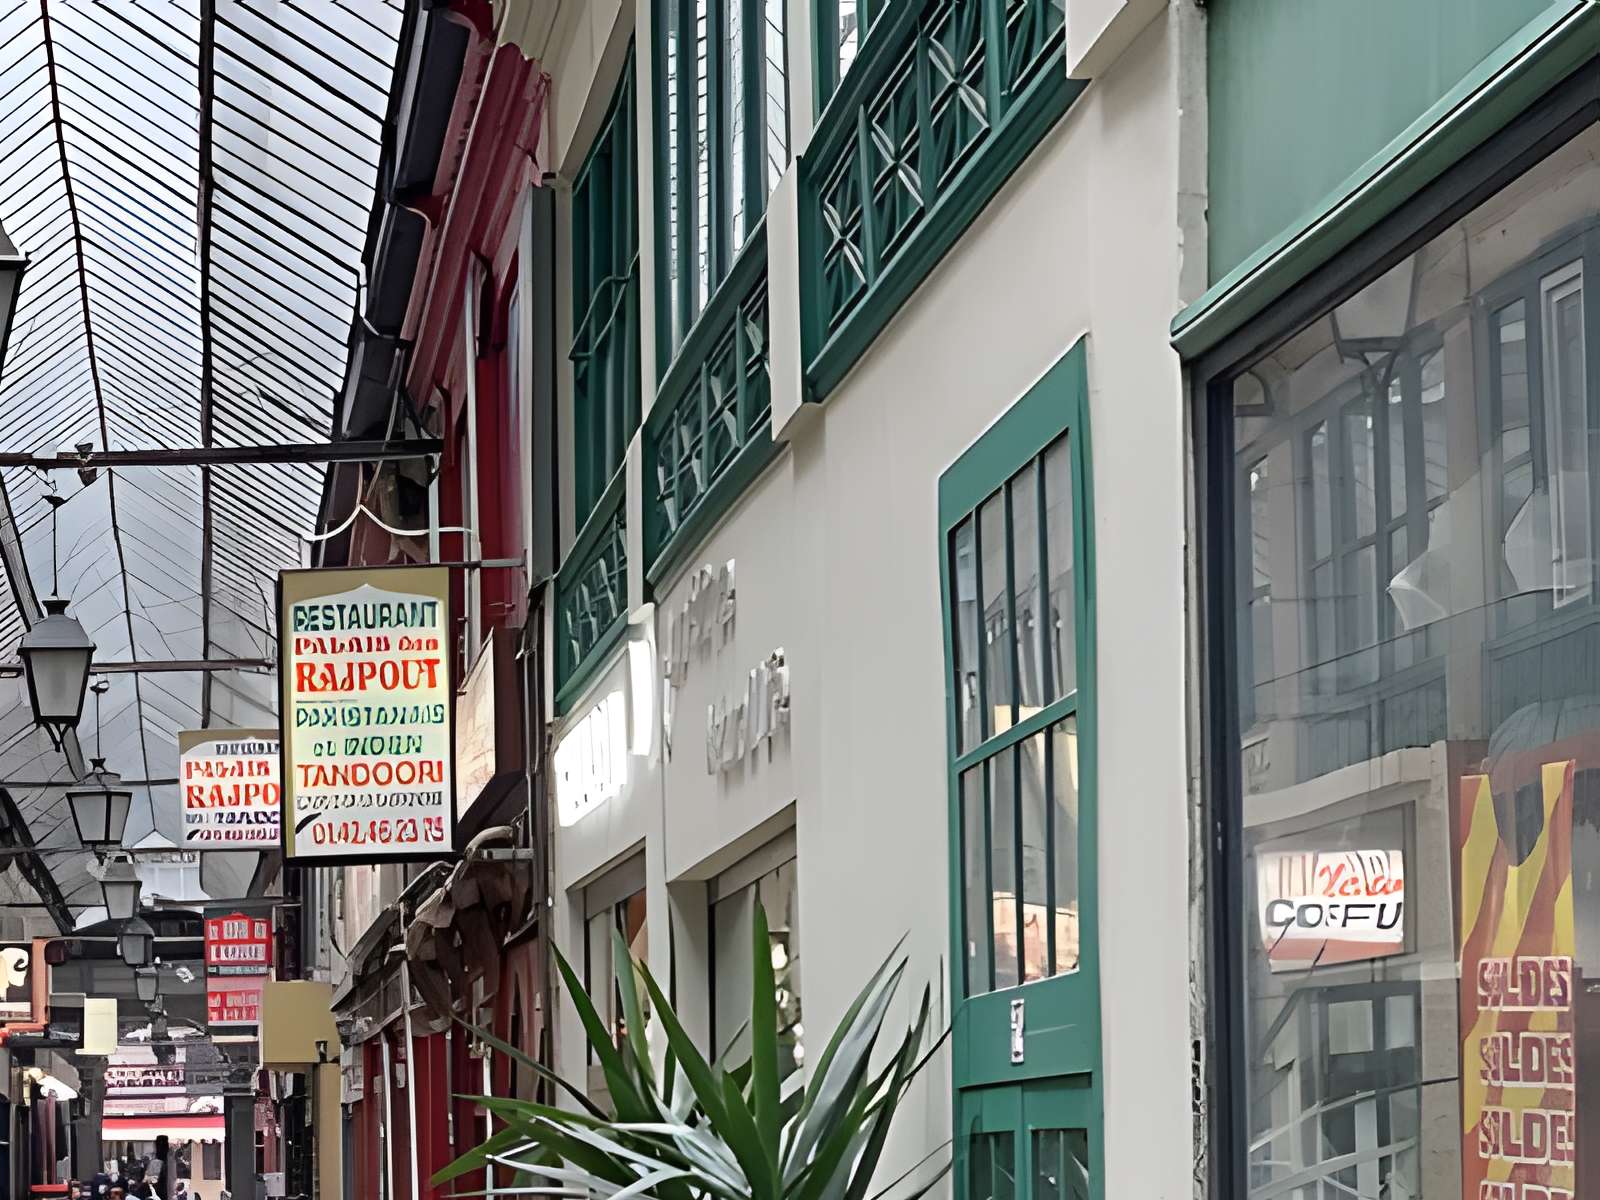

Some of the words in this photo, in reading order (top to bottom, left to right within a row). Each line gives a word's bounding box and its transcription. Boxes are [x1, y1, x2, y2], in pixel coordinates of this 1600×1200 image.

[294, 601, 438, 632] RESTAURANT
[296, 658, 440, 692] RAJPOUT
[297, 761, 443, 787] TANDOORI
